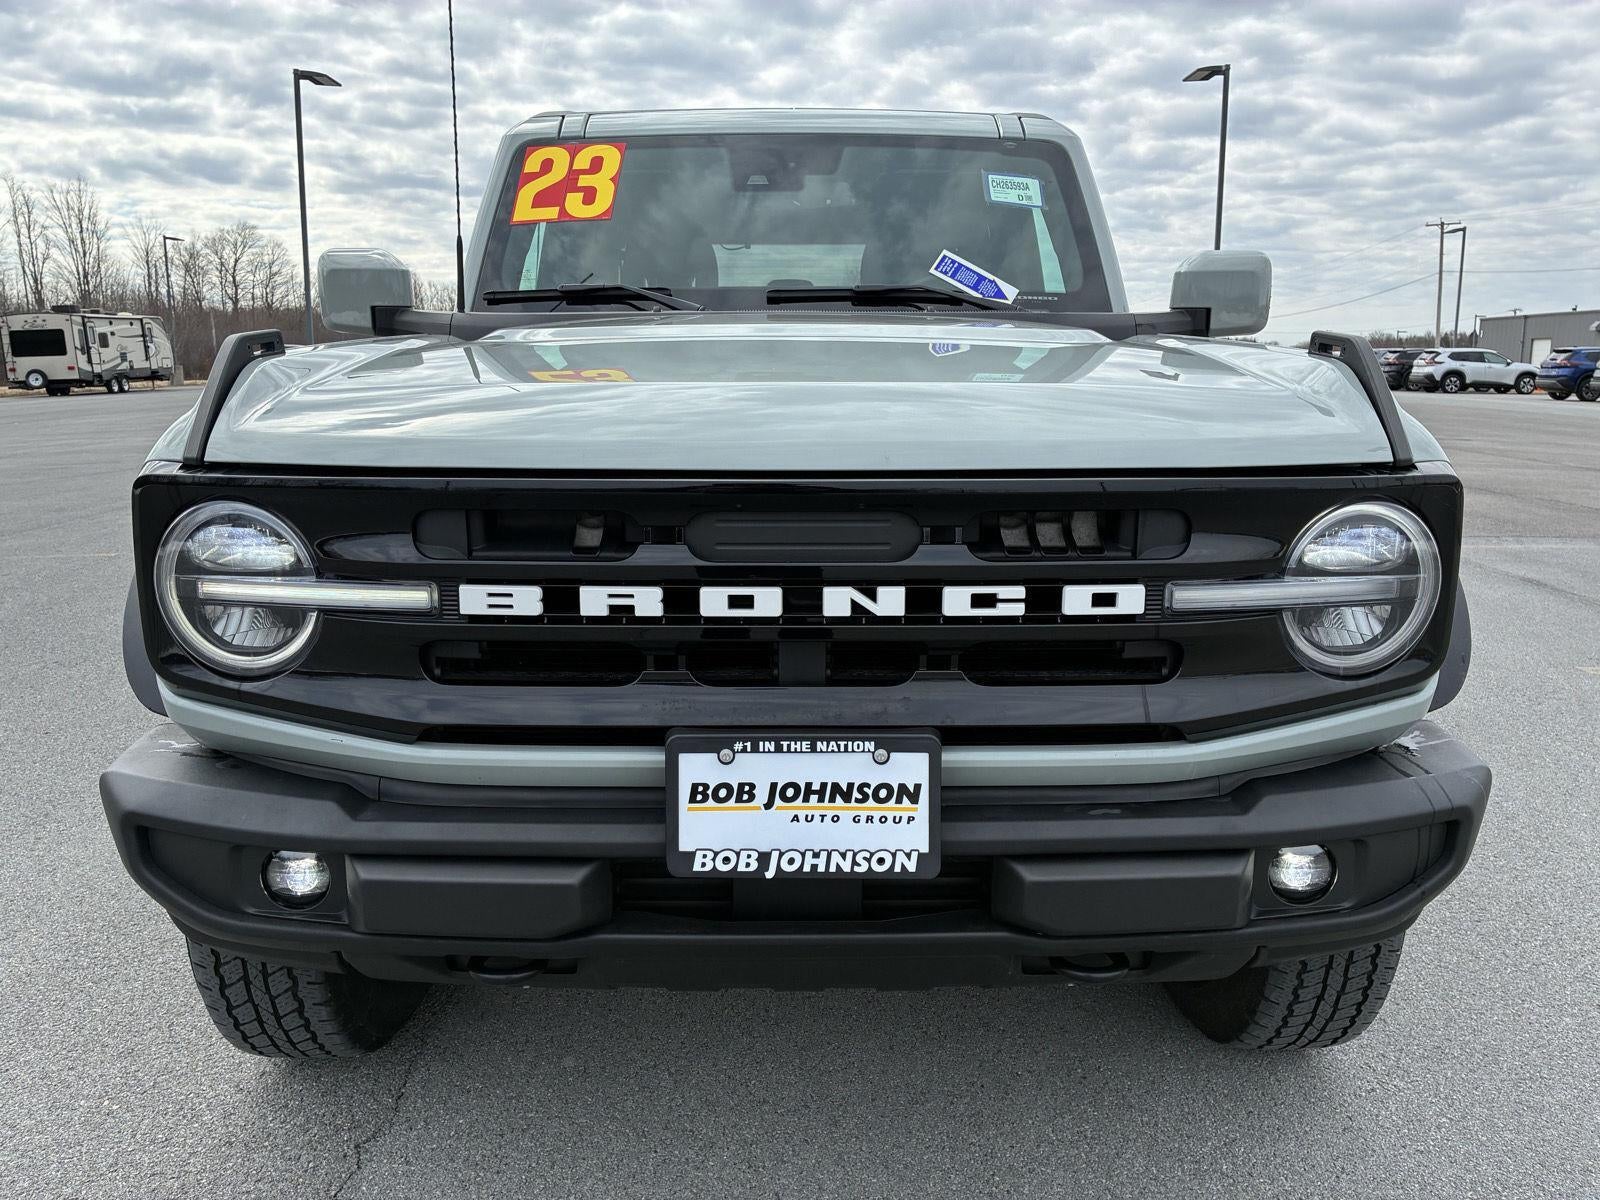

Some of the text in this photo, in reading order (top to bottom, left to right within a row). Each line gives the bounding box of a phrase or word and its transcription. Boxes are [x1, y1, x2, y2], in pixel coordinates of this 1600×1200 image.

[512, 144, 622, 222] 23
[459, 584, 1146, 618] BRONCO
[733, 741, 875, 752] #1 IN THE NATION
[688, 781, 922, 810] BOB JOHNSON
[790, 814, 916, 824] AUTO GROUP
[692, 849, 919, 880] BOB JOHNSON
